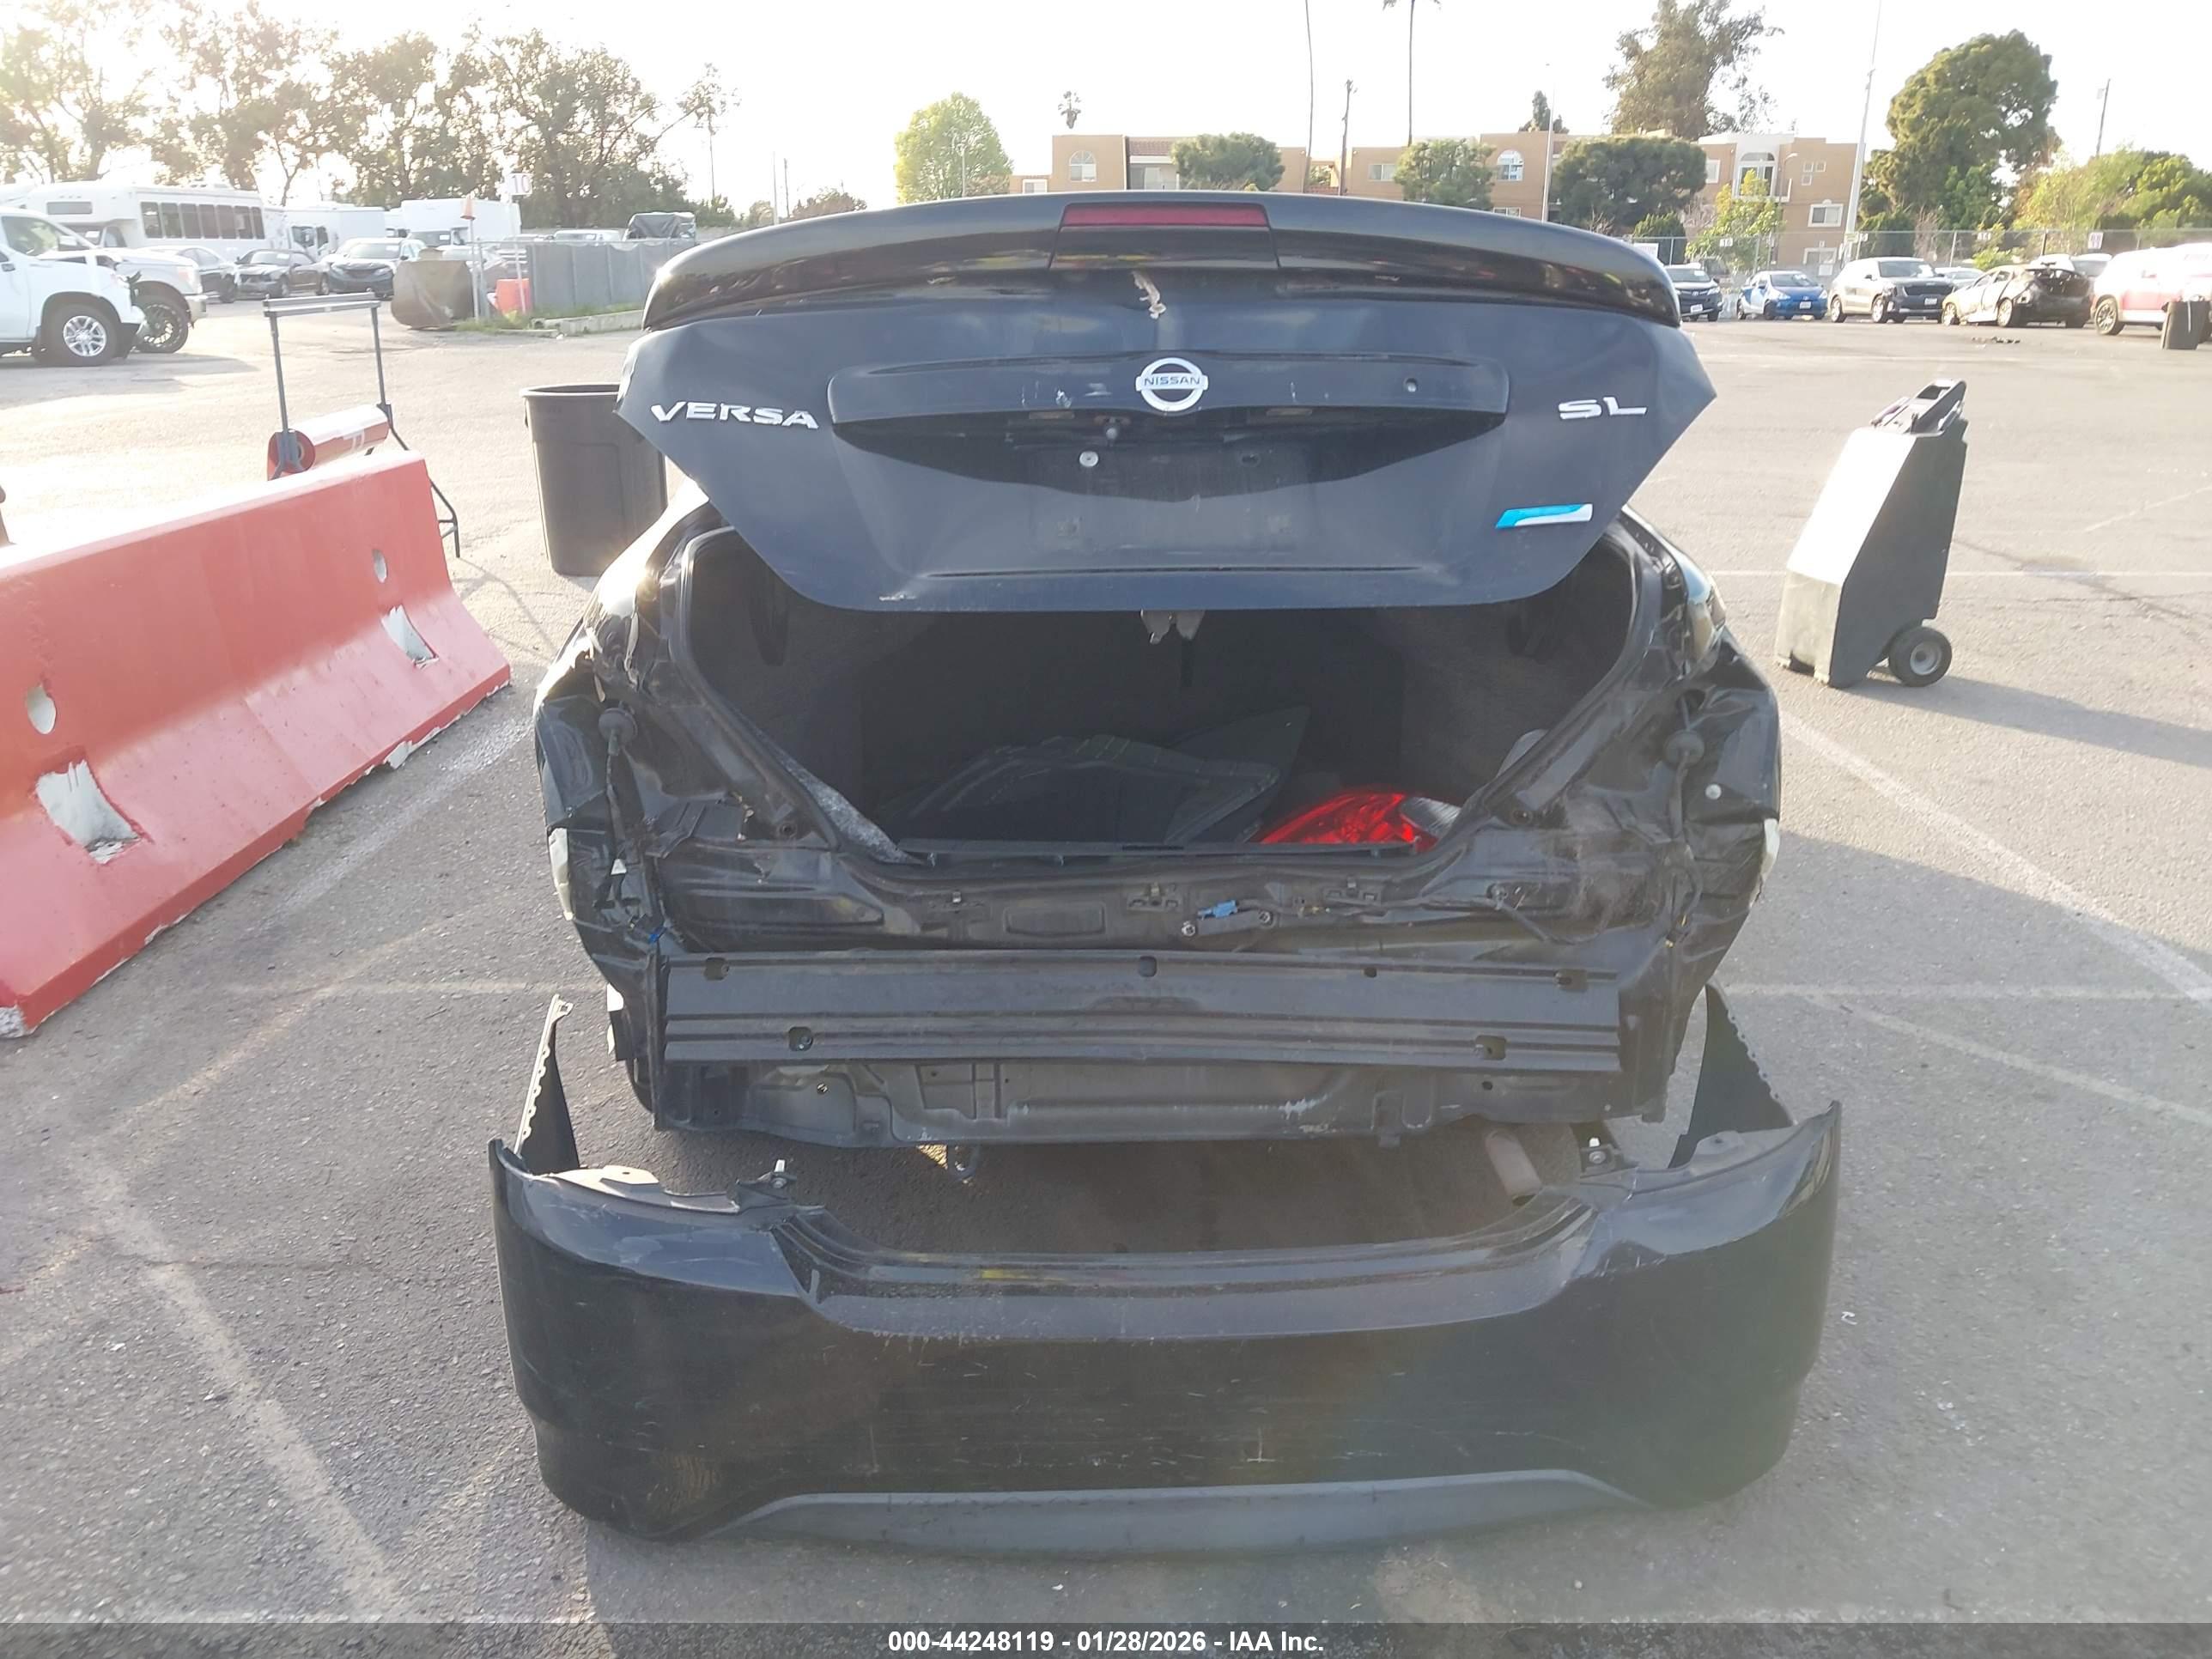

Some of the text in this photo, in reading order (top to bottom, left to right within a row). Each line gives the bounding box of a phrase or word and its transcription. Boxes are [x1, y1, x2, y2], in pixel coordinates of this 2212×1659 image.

[512, 174, 530, 193] 10
[1145, 376, 1200, 386] NISSAN
[651, 401, 818, 429] VERSA
[1559, 397, 1647, 419] SL
